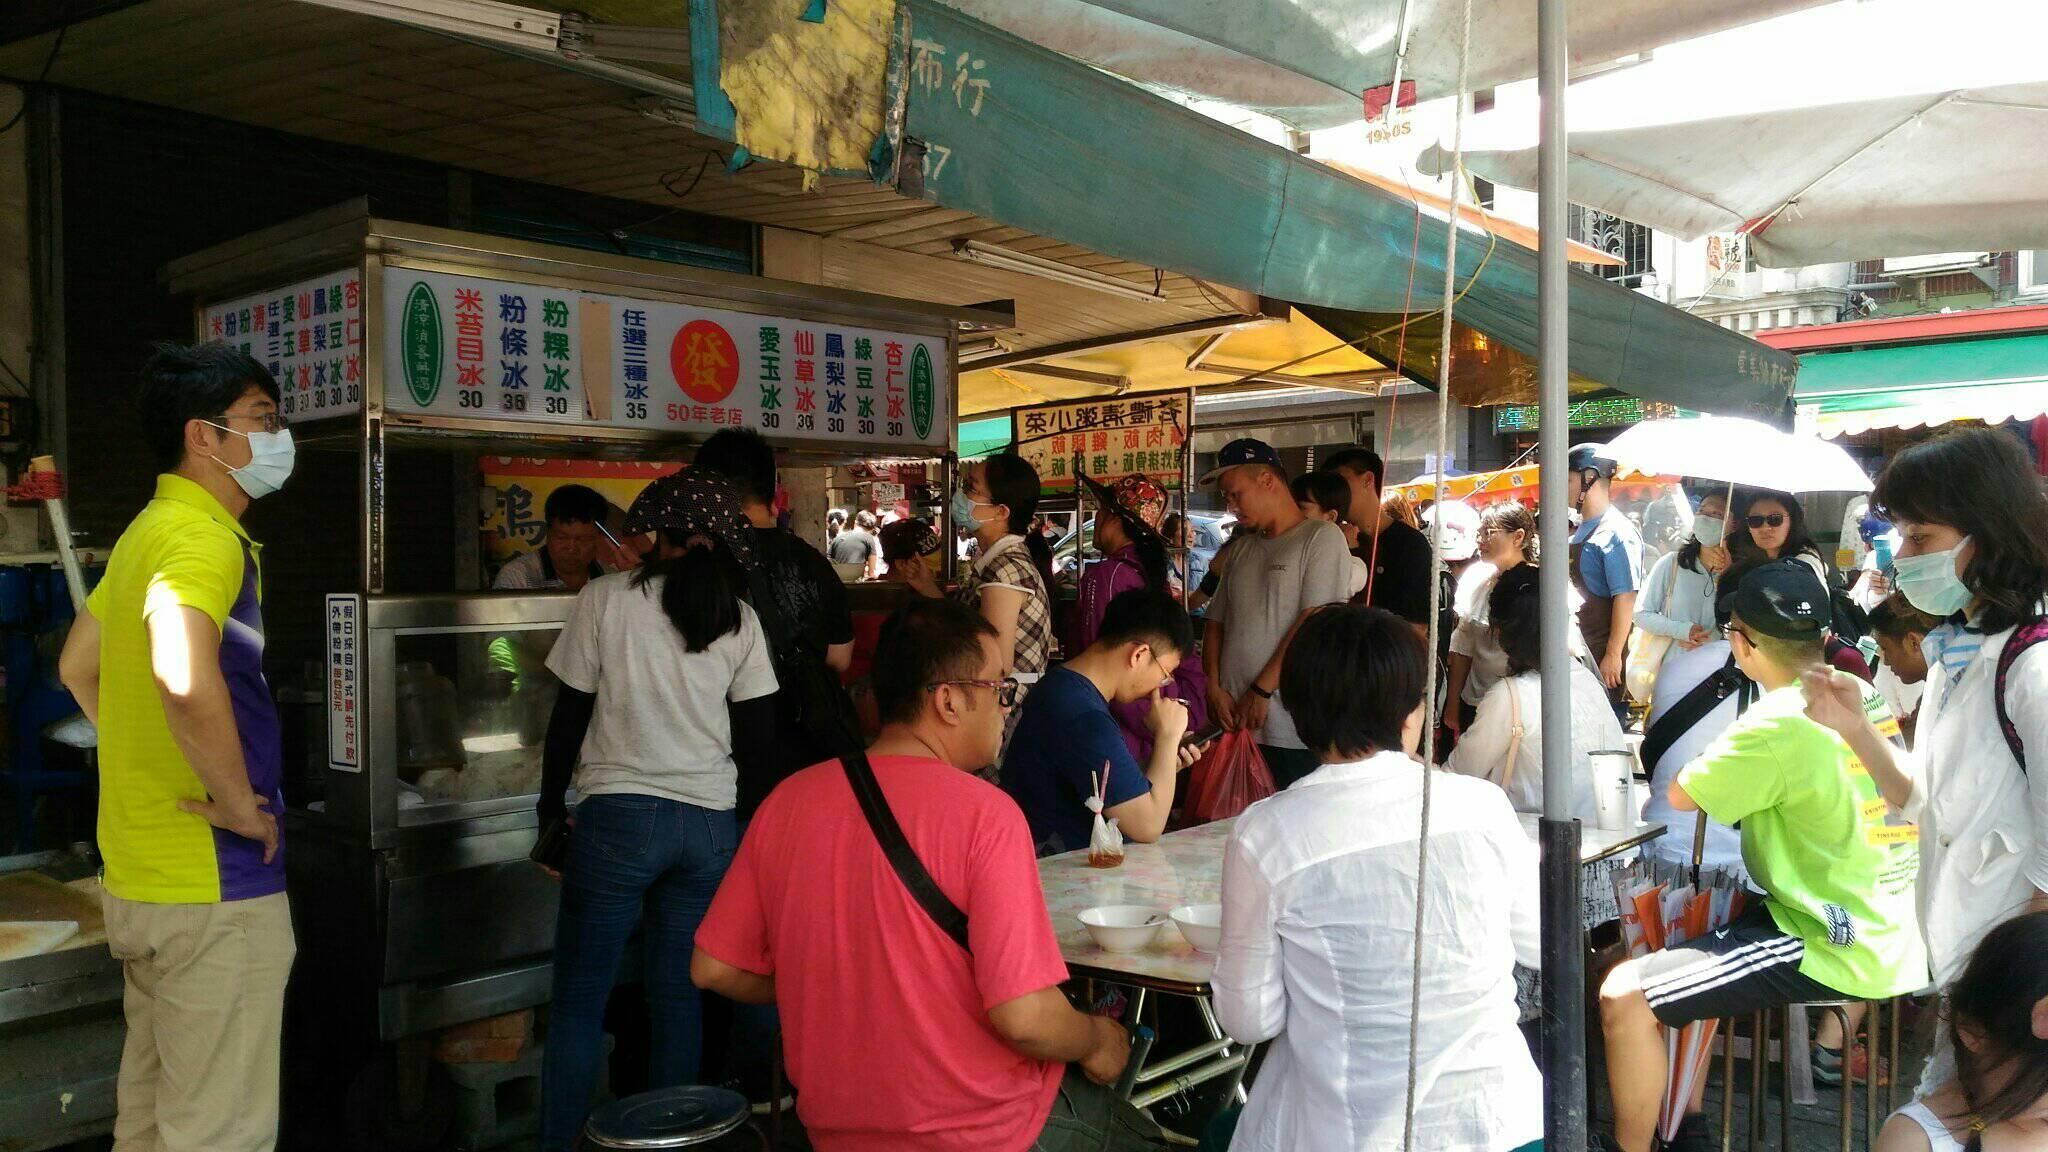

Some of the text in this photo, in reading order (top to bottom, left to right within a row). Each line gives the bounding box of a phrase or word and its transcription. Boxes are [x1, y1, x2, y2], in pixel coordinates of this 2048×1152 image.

[298, 292, 311, 391] 仙草冰
[329, 285, 343, 405] 綠豆冰 30
[345, 280, 360, 402] 杏仁冰 30
[455, 288, 485, 408] 米苔目冰 30
[499, 293, 528, 389] 粉條冰
[542, 299, 570, 414] 粉粿冰 30
[622, 309, 648, 419] 任選三種冰 35
[759, 326, 782, 429] 愛玉冰 30
[794, 330, 816, 414] 仙草冰
[825, 333, 847, 433] 鳳梨冰 30
[854, 337, 875, 435] 綠豆冰 30
[884, 341, 905, 437] 杏仁冰 30
[284, 396, 294, 414] 30
[315, 391, 325, 408] 30
[667, 403, 742, 425] 50年老店
